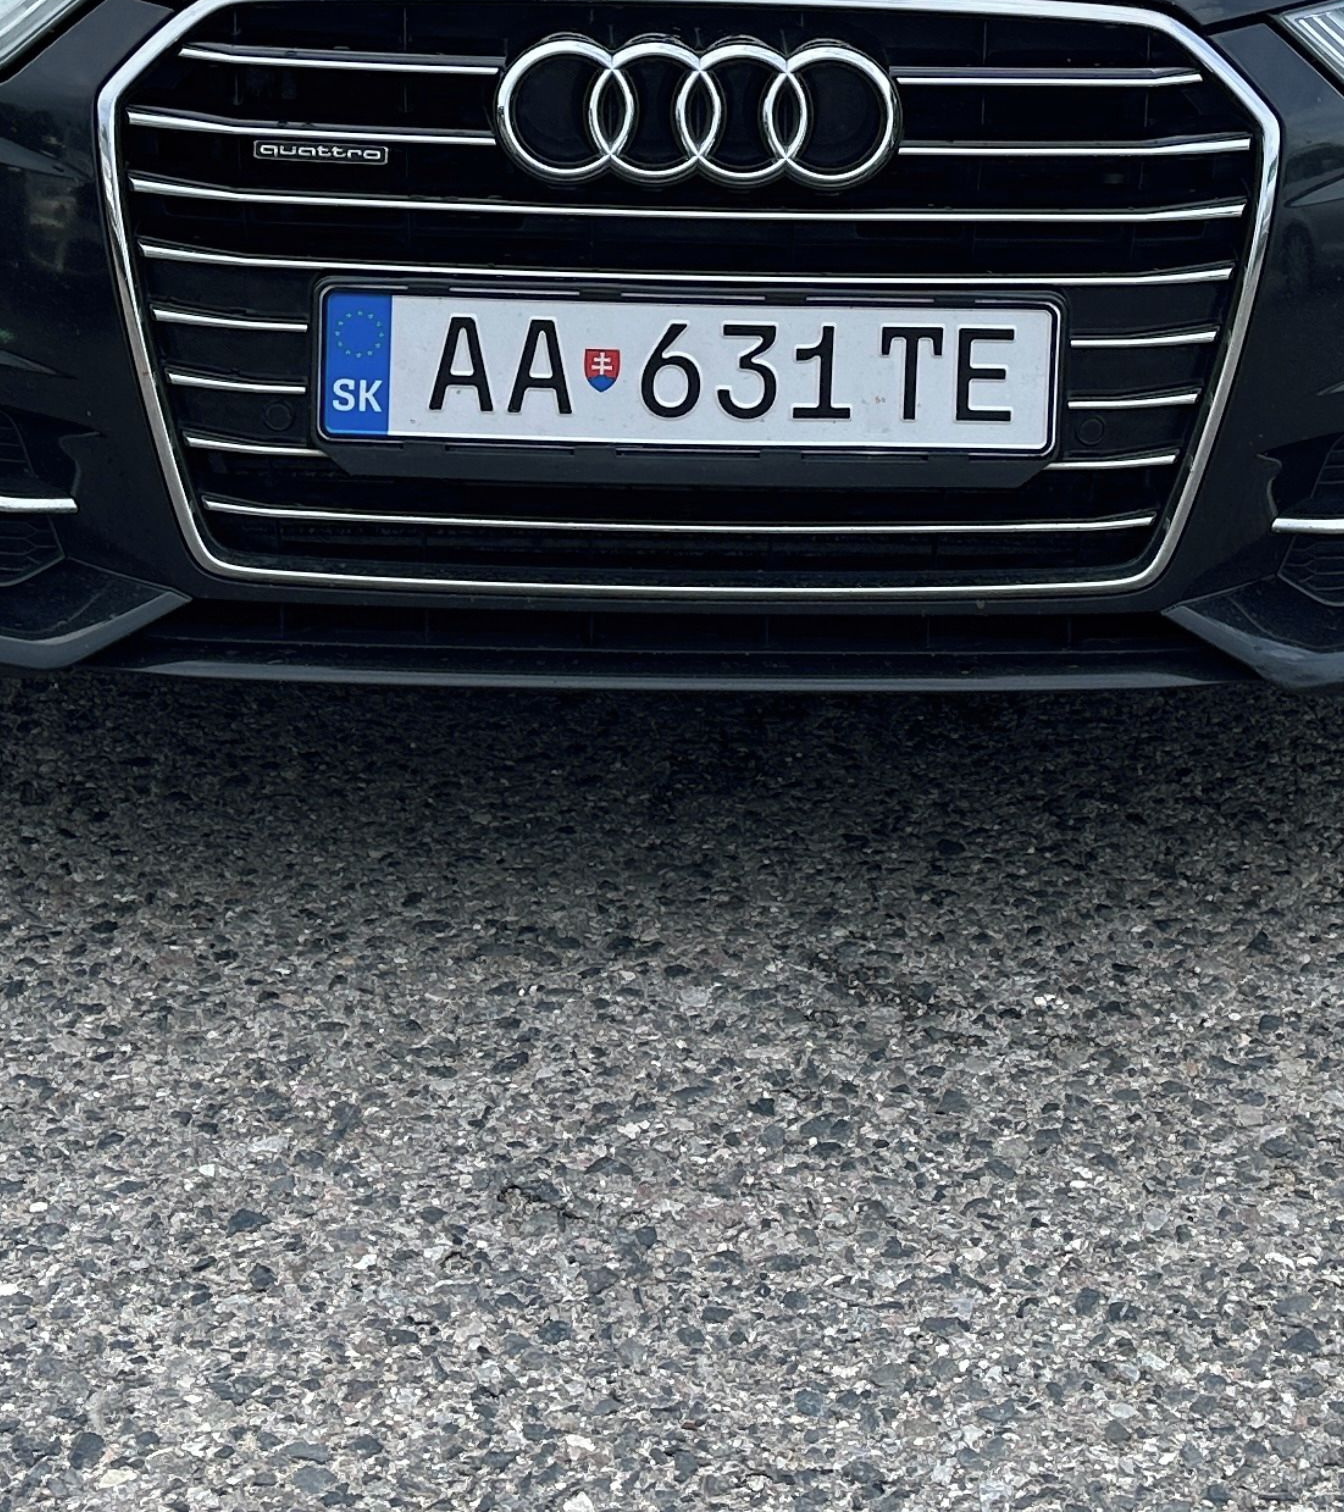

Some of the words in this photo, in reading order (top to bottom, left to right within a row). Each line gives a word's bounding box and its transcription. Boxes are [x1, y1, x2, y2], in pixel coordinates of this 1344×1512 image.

[259, 144, 382, 161] quattro
[427, 315, 574, 416] AA
[332, 378, 383, 413] SK
